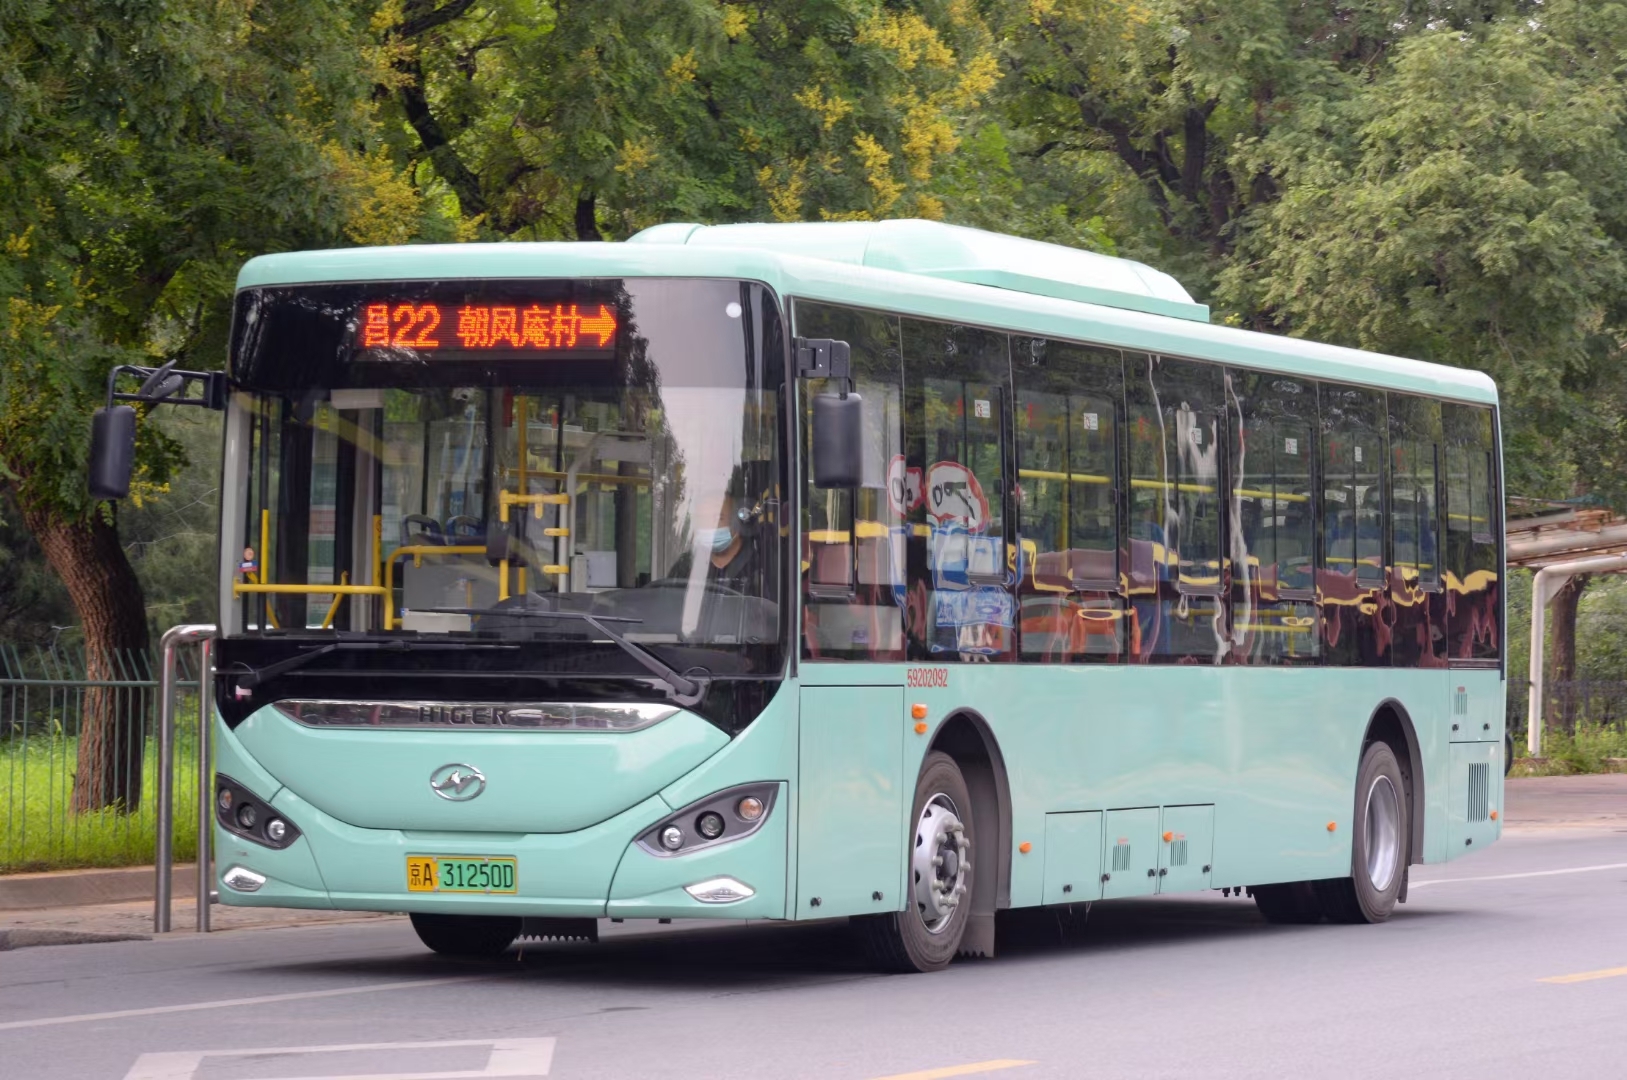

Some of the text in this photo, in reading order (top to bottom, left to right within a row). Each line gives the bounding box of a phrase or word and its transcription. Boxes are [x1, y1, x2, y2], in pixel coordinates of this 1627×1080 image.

[364, 305, 581, 347] 昌22 朝凤庵村
[907, 668, 948, 688] 59202092
[418, 706, 507, 725] HIGER
[410, 863, 514, 888] 京A 31250D
